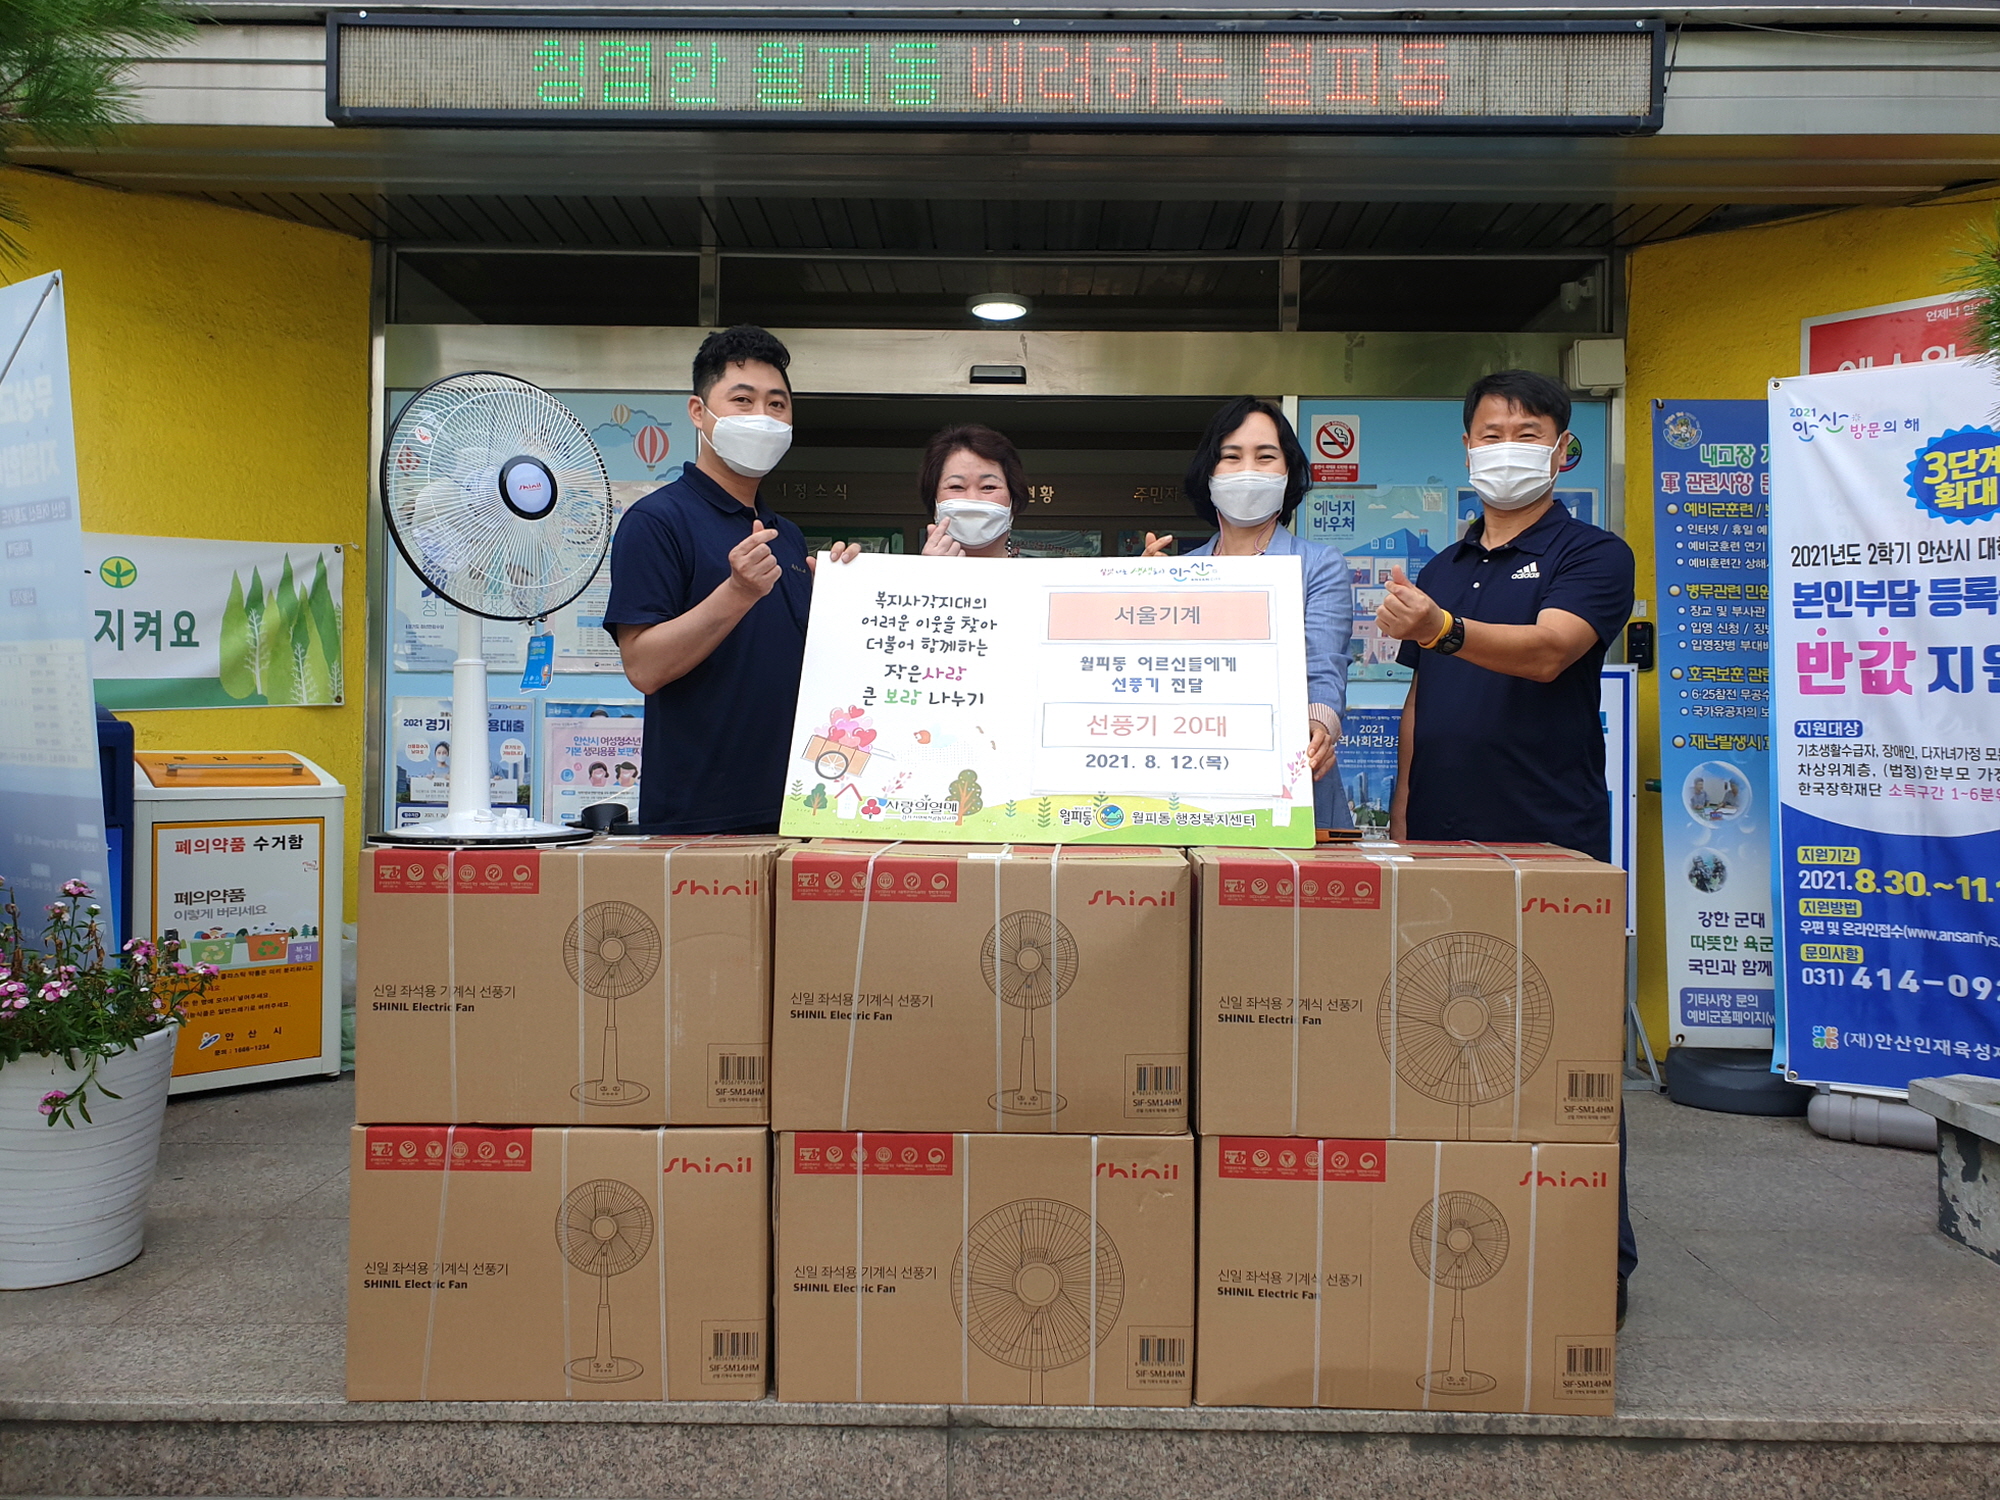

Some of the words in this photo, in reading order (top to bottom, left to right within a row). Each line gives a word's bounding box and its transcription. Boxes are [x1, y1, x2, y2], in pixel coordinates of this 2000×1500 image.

[752, 41, 941, 104] 월피동
[971, 41, 1228, 105] 배려하는
[1261, 42, 1449, 106] 월피동
[1926, 307, 1960, 322] 언제나
[1789, 408, 1816, 417] 2021
[1850, 419, 1897, 440] 방문의
[1903, 418, 1919, 432] 해
[1701, 444, 1755, 468] 내고장
[1661, 472, 1680, 493] 軍
[1686, 472, 1754, 496] 관련사항
[1934, 476, 1998, 510] 확대
[1313, 500, 1355, 515] 에너지
[1683, 502, 1754, 518] 예비군훈련
[1313, 517, 1355, 532] 바우처
[1687, 524, 1719, 536] 인터넷
[1732, 524, 1753, 536] 휴일
[1688, 541, 1741, 552] 예비군훈련
[1744, 541, 1766, 552] 연기
[1790, 543, 1862, 568] 2021년도
[1867, 541, 1911, 565] 2학기
[1918, 538, 1971, 564] 안산시
[1688, 557, 1742, 569] 예비훈련간
[1510, 572, 1540, 580] adidas
[875, 591, 987, 609] 복지사각지대의
[1685, 584, 1742, 600] 병무관련
[1792, 579, 1920, 620] 본인부담
[1928, 576, 1999, 618] 등록
[1114, 605, 1201, 625] 서울기계
[1690, 606, 1712, 617] 장교
[1716, 606, 1727, 617] 및
[1731, 606, 1766, 617] 부사관
[94, 608, 200, 652] 지켜요
[862, 614, 910, 632] 어려운
[916, 615, 956, 634] 이웃을
[961, 615, 998, 633] 찾아
[1690, 622, 1713, 634] 입영
[1717, 622, 1740, 634] 신청
[866, 635, 914, 654] 더불어
[921, 637, 988, 657] 함께하는
[1691, 639, 1736, 651] 입영장병
[1080, 656, 1127, 672] 월피동
[1137, 656, 1237, 673] 어르신들에게
[1797, 640, 1917, 696] 반값
[1687, 666, 1744, 682] 호국보훈
[1111, 677, 1159, 693] 선풍기
[1171, 678, 1203, 694] 전달
[862, 686, 877, 706] 큰
[884, 688, 922, 705] 보람
[929, 691, 984, 707] 나누기
[1692, 705, 1758, 718] 국가유공자의
[403, 718, 422, 727] 2021
[1087, 714, 1157, 736] 선풍기
[1173, 715, 1228, 737] 20대
[1359, 724, 1384, 734] 2021
[1797, 722, 1860, 737] 지원대상
[573, 736, 599, 747] 안산시
[1334, 735, 1399, 748] 역사회건강
[1688, 733, 1761, 750] 재난발생시
[565, 747, 582, 757] 기본
[583, 747, 617, 757] 생리용품
[1797, 743, 1879, 759] 기초생활수급자,
[1882, 744, 1918, 760] 장애인,
[1921, 746, 1981, 762] 다자녀가정
[1085, 753, 1136, 769] 2021.
[1144, 754, 1161, 769] 8.
[1171, 755, 1230, 771] 12.(목)
[1798, 763, 1876, 779] 차상위계층,
[1883, 763, 1971, 781] (법정)한부모
[1798, 782, 1882, 798] 한국장학재단
[1888, 784, 1945, 801] 소득구간
[885, 800, 958, 815] 사랑의열매
[1059, 808, 1093, 826] 월피동
[1131, 812, 1170, 824] 월피동
[1176, 812, 1256, 827] 행정복지센터
[174, 837, 246, 855] 폐의약품
[253, 834, 304, 852] 수거함
[1801, 848, 1856, 863] 지원기간
[671, 879, 758, 896] Shinil
[174, 888, 247, 906] 폐의약품
[1088, 889, 1175, 907] Shinil
[174, 908, 214, 921] 이렇게
[217, 905, 268, 919] 버리세요
[1521, 897, 1611, 914] Shinil
[1803, 901, 1857, 916] 지원방법
[1698, 911, 1730, 928] 강한
[1734, 912, 1765, 929] 군대
[1800, 921, 1825, 935] 우편
[1827, 922, 1840, 936] 및
[1690, 935, 1738, 952] 따뜻한
[1743, 935, 1774, 953] 육군
[1804, 945, 1860, 962] 문의사항
[1688, 959, 1737, 976] 국민과
[1742, 959, 1773, 977] 함께
[373, 984, 397, 998] 신일
[400, 984, 437, 998] 좌석용
[480, 985, 516, 999] 선풍기
[1802, 967, 1845, 987] 031)
[1851, 966, 2000, 1002] 414-09
[372, 1002, 409, 1012] SHINIL
[456, 1003, 475, 1012] Fan
[791, 992, 815, 1006] 신일
[818, 992, 854, 1007] 좌석용
[897, 994, 934, 1008] 선풍기
[1218, 995, 1242, 1010] 신일
[1246, 996, 1283, 1010] 좌석용
[1327, 998, 1363, 1012] 선풍기
[1686, 993, 1732, 1008] 기타사항
[1736, 994, 1759, 1008] 문의
[790, 1009, 827, 1019] SHINIL
[873, 1011, 893, 1021] Fan
[1217, 1013, 1255, 1024] SHINIL
[1302, 1015, 1322, 1026] Fan
[715, 1088, 765, 1096] SIF-SM14HM
[1132, 1098, 1182, 1107] SIF-SM14HM
[1564, 1105, 1614, 1115] SIF-SM14HM
[663, 1156, 752, 1174] Shinil
[1096, 1161, 1179, 1181] Shinil
[1518, 1170, 1607, 1188] Shinil
[364, 1261, 389, 1276] 신일
[392, 1262, 429, 1276] 좌석용
[473, 1263, 509, 1277] 선풍기
[794, 1265, 818, 1279] 신일
[821, 1265, 858, 1280] 좌석용
[860, 1266, 897, 1280] 기계식
[900, 1266, 938, 1281] 선풍기
[364, 1279, 402, 1289] SHINIL
[448, 1280, 468, 1290] Fan
[1218, 1269, 1242, 1284] 신일
[1245, 1270, 1283, 1285] 좌석용
[1326, 1272, 1363, 1288] 선풍기
[793, 1283, 830, 1293] SHINIL
[877, 1284, 896, 1294] Fan
[1217, 1287, 1255, 1298] SHINIL
[1257, 1288, 1299, 1299] Electric
[708, 1363, 759, 1373] SIF-SM14HM
[1135, 1369, 1186, 1379] SIF-SM14HM
[1562, 1379, 1612, 1389] SIF-SM14HM
